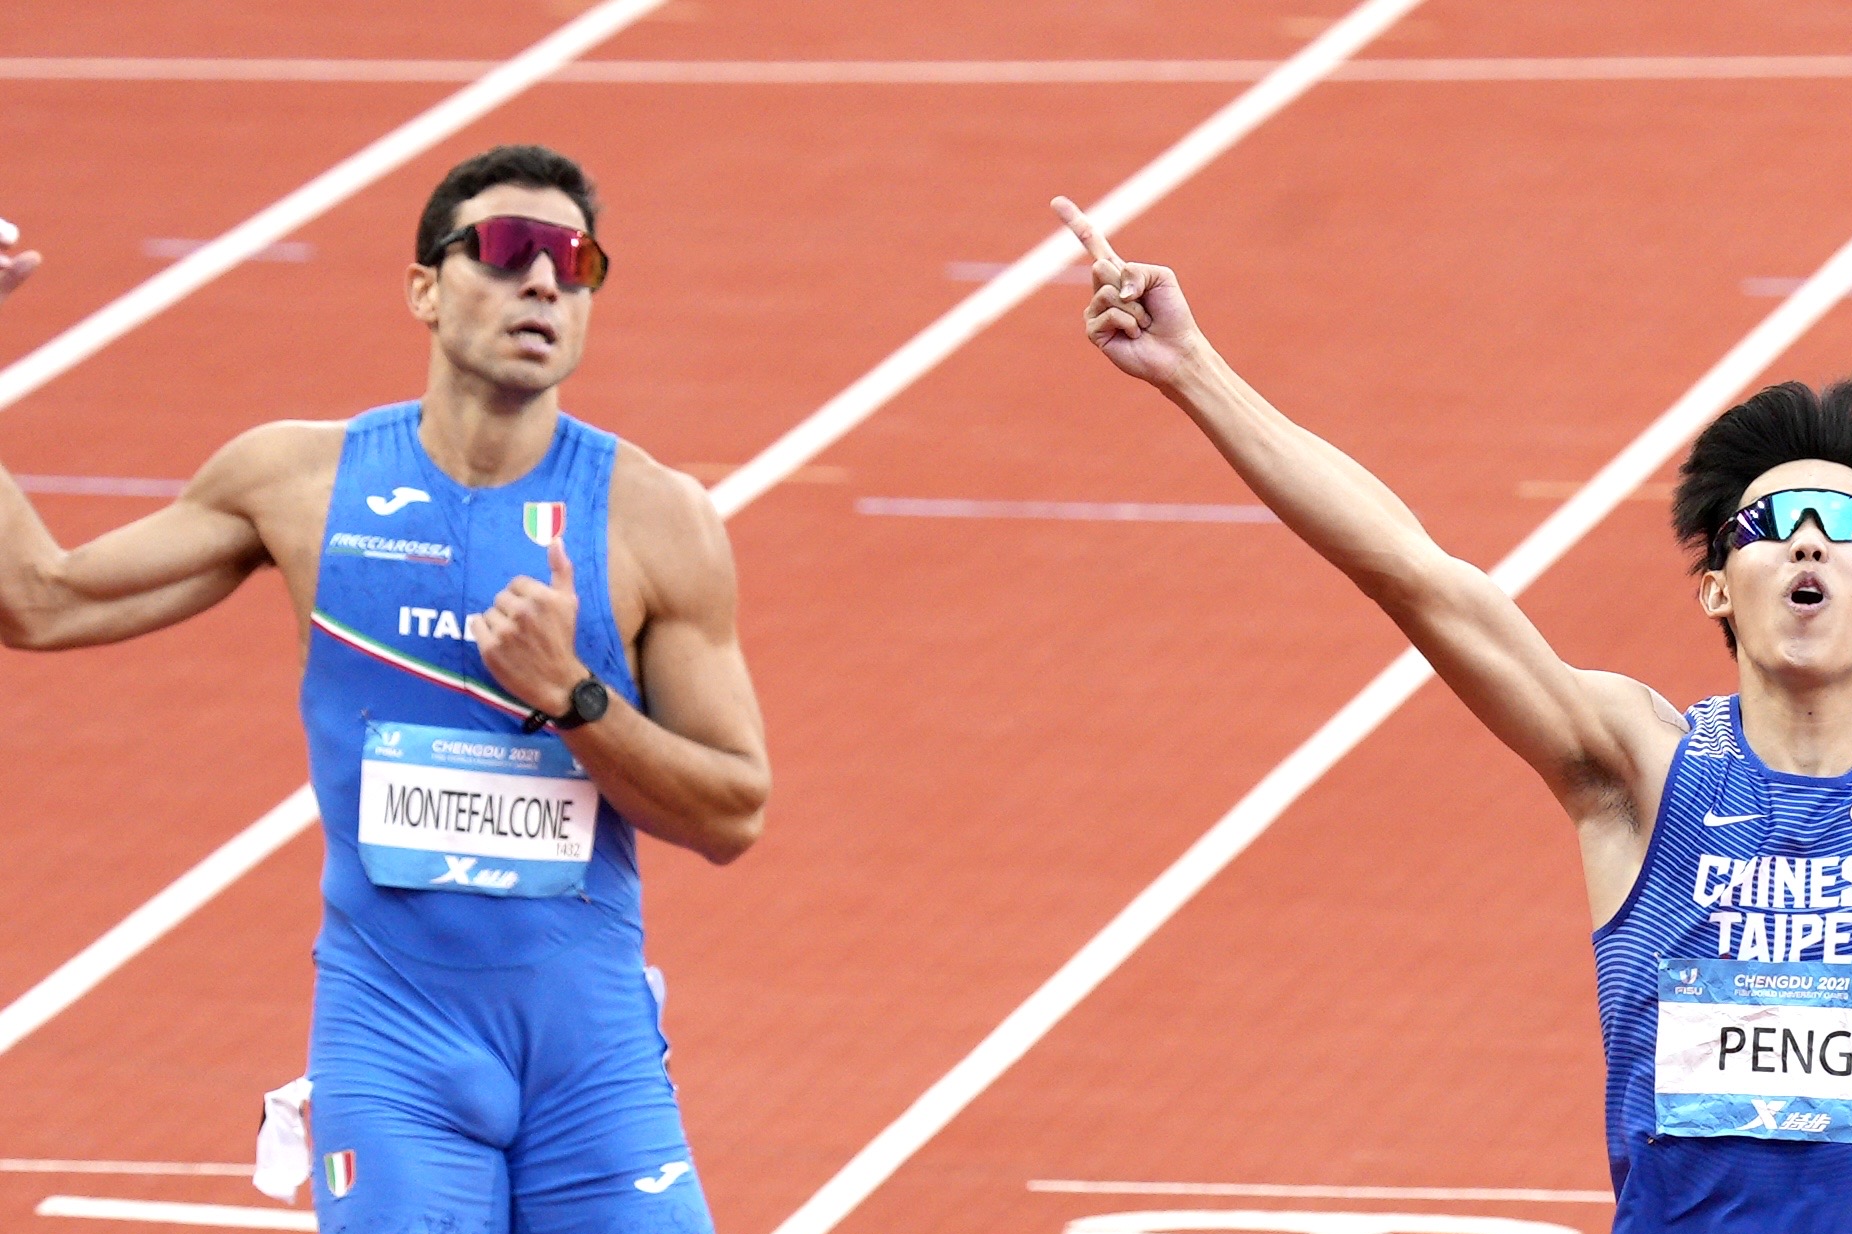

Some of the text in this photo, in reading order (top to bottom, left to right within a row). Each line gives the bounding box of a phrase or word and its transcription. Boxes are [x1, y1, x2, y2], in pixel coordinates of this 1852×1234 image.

[329, 532, 452, 558] FRECCIAROSSA
[398, 606, 478, 642] ITA
[431, 739, 505, 760] CHENGDU
[509, 747, 541, 763] 2021
[384, 783, 574, 840] MONTEFALCONE
[1674, 986, 1703, 996] FISU
[1734, 973, 1850, 990] CHENGDU 2021
[1719, 1026, 1852, 1076] PENG
[1779, 1111, 1831, 1133] 特步
